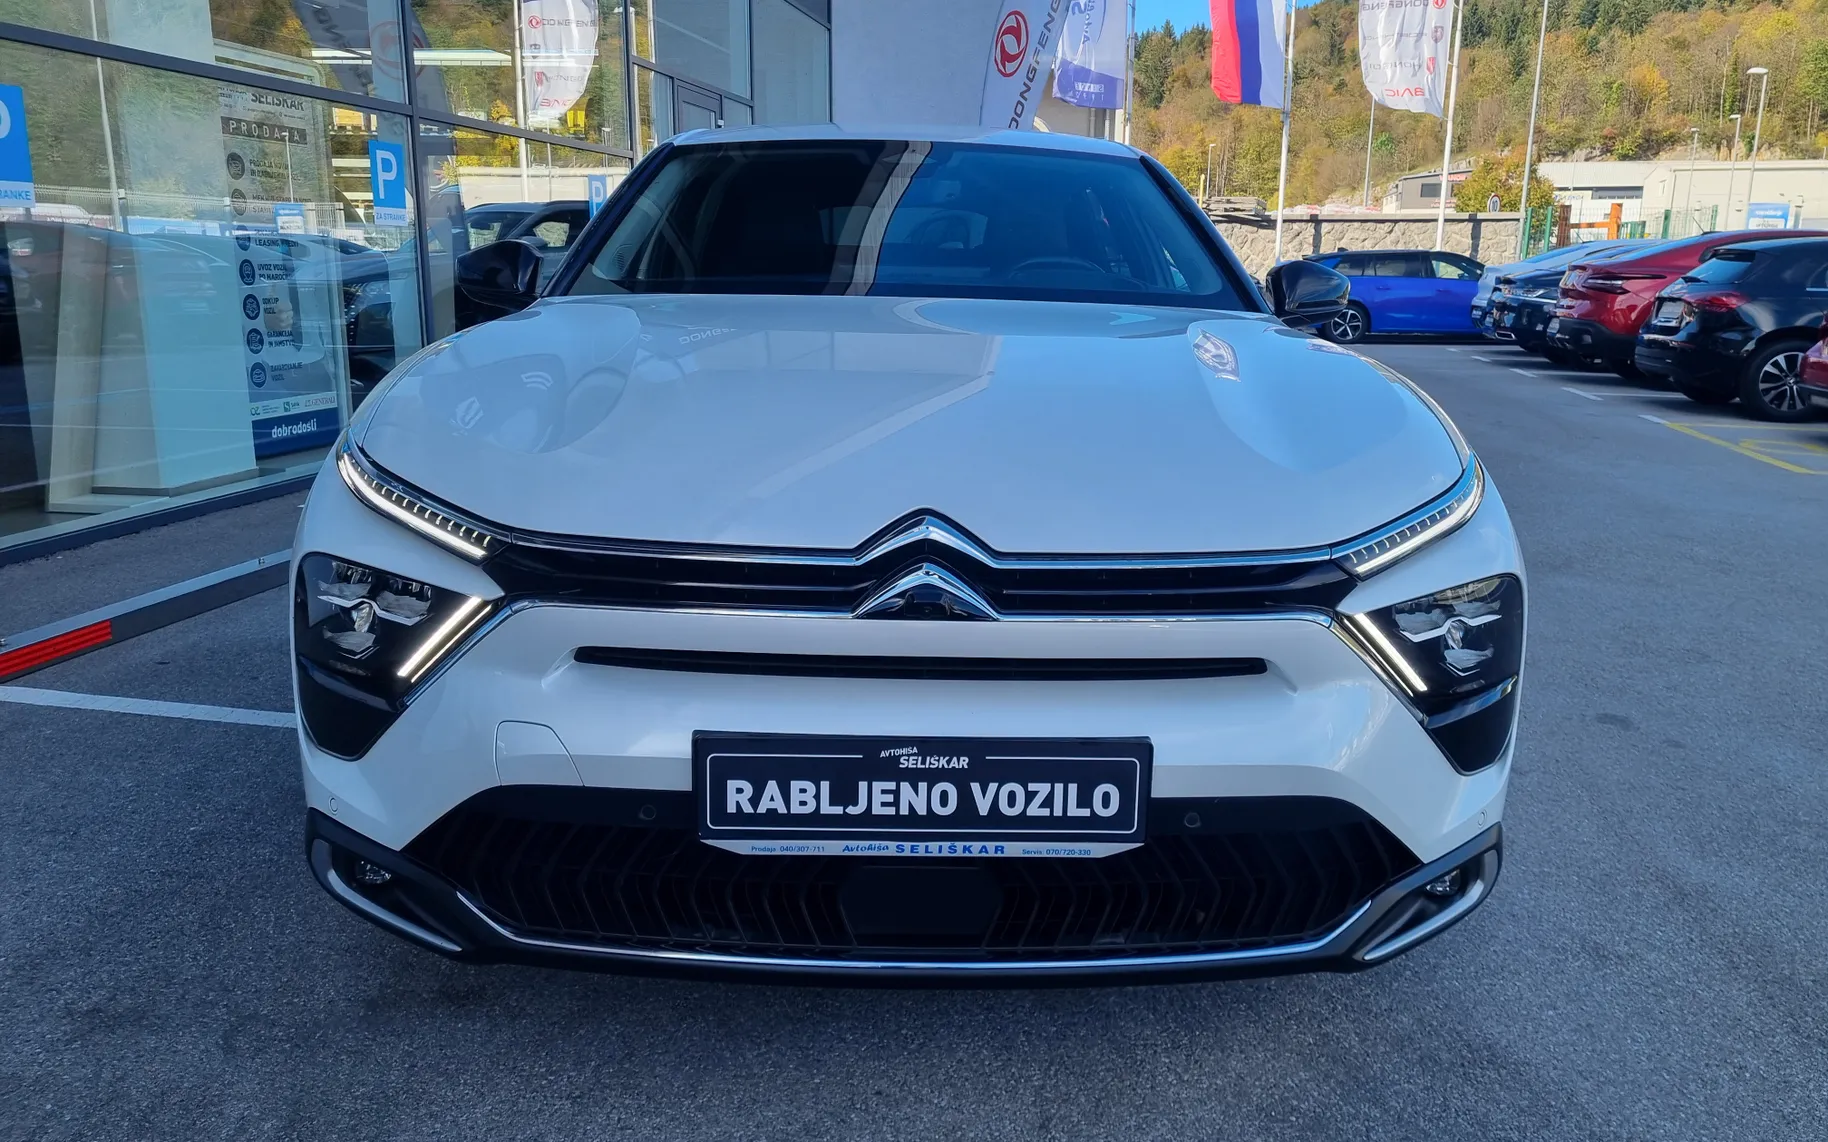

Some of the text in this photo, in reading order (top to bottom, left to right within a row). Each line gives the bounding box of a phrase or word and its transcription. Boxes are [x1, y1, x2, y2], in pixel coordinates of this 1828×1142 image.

[376, 150, 397, 200] P
[899, 755, 969, 768] SELIŠKAR
[726, 780, 1119, 817] RABLJENO VOZILO
[895, 843, 1005, 855] SELIŠKAR
[1046, 848, 1091, 856] 070/720-330
